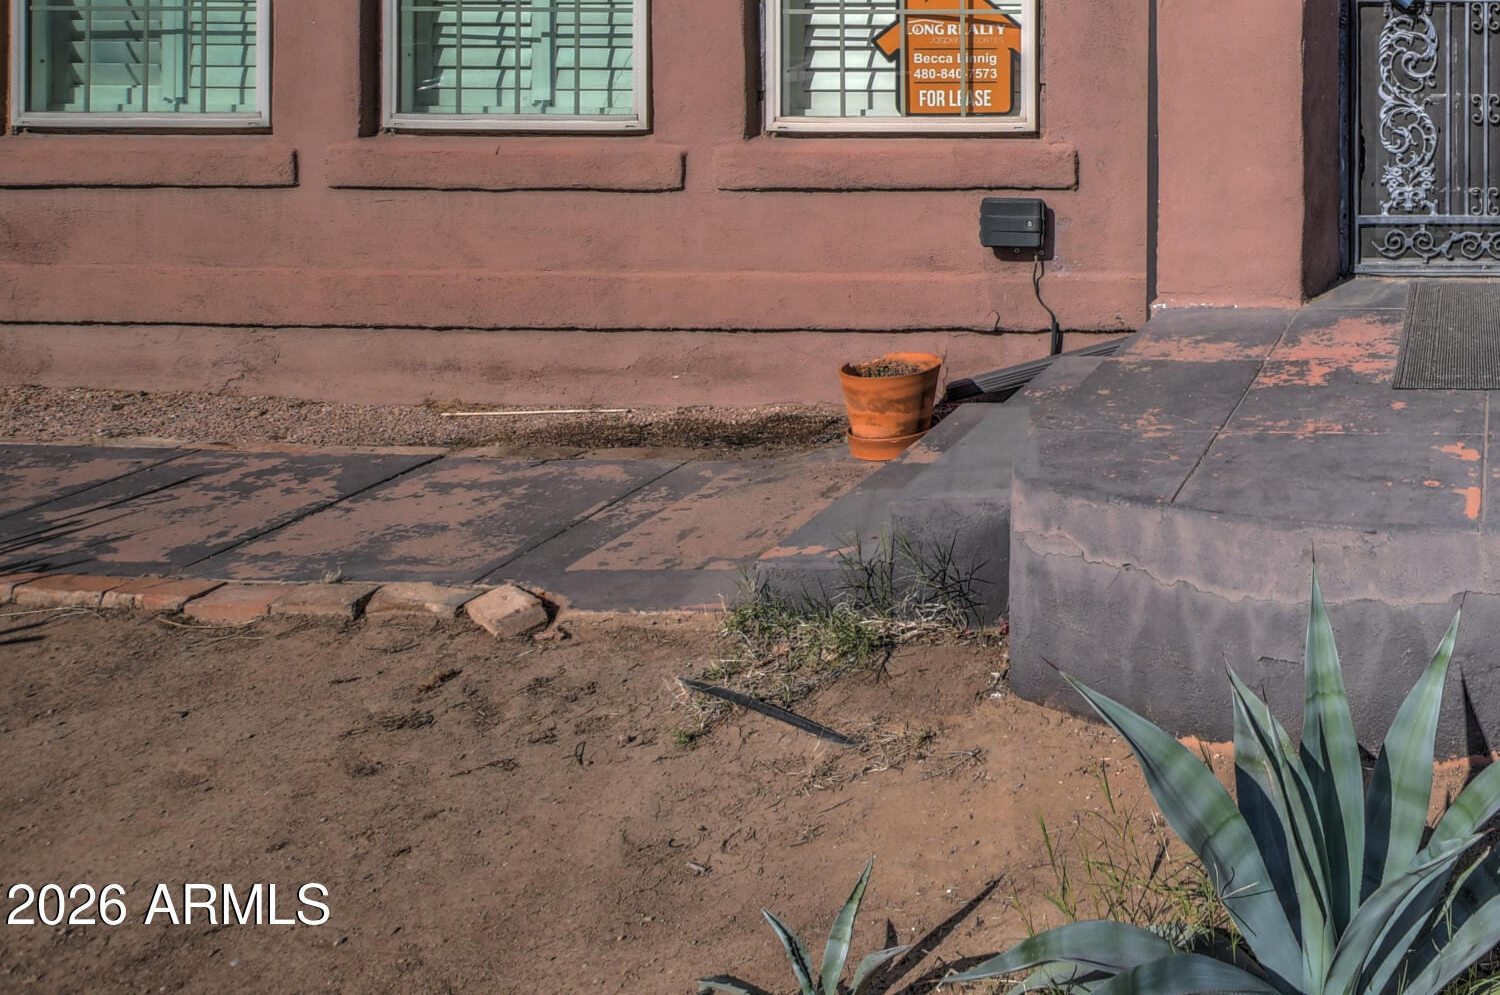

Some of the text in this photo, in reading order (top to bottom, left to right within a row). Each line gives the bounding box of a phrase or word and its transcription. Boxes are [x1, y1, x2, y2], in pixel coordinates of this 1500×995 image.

[907, 23, 944, 35] LONG
[913, 53, 953, 64] Becca
[919, 90, 945, 107] FOR
